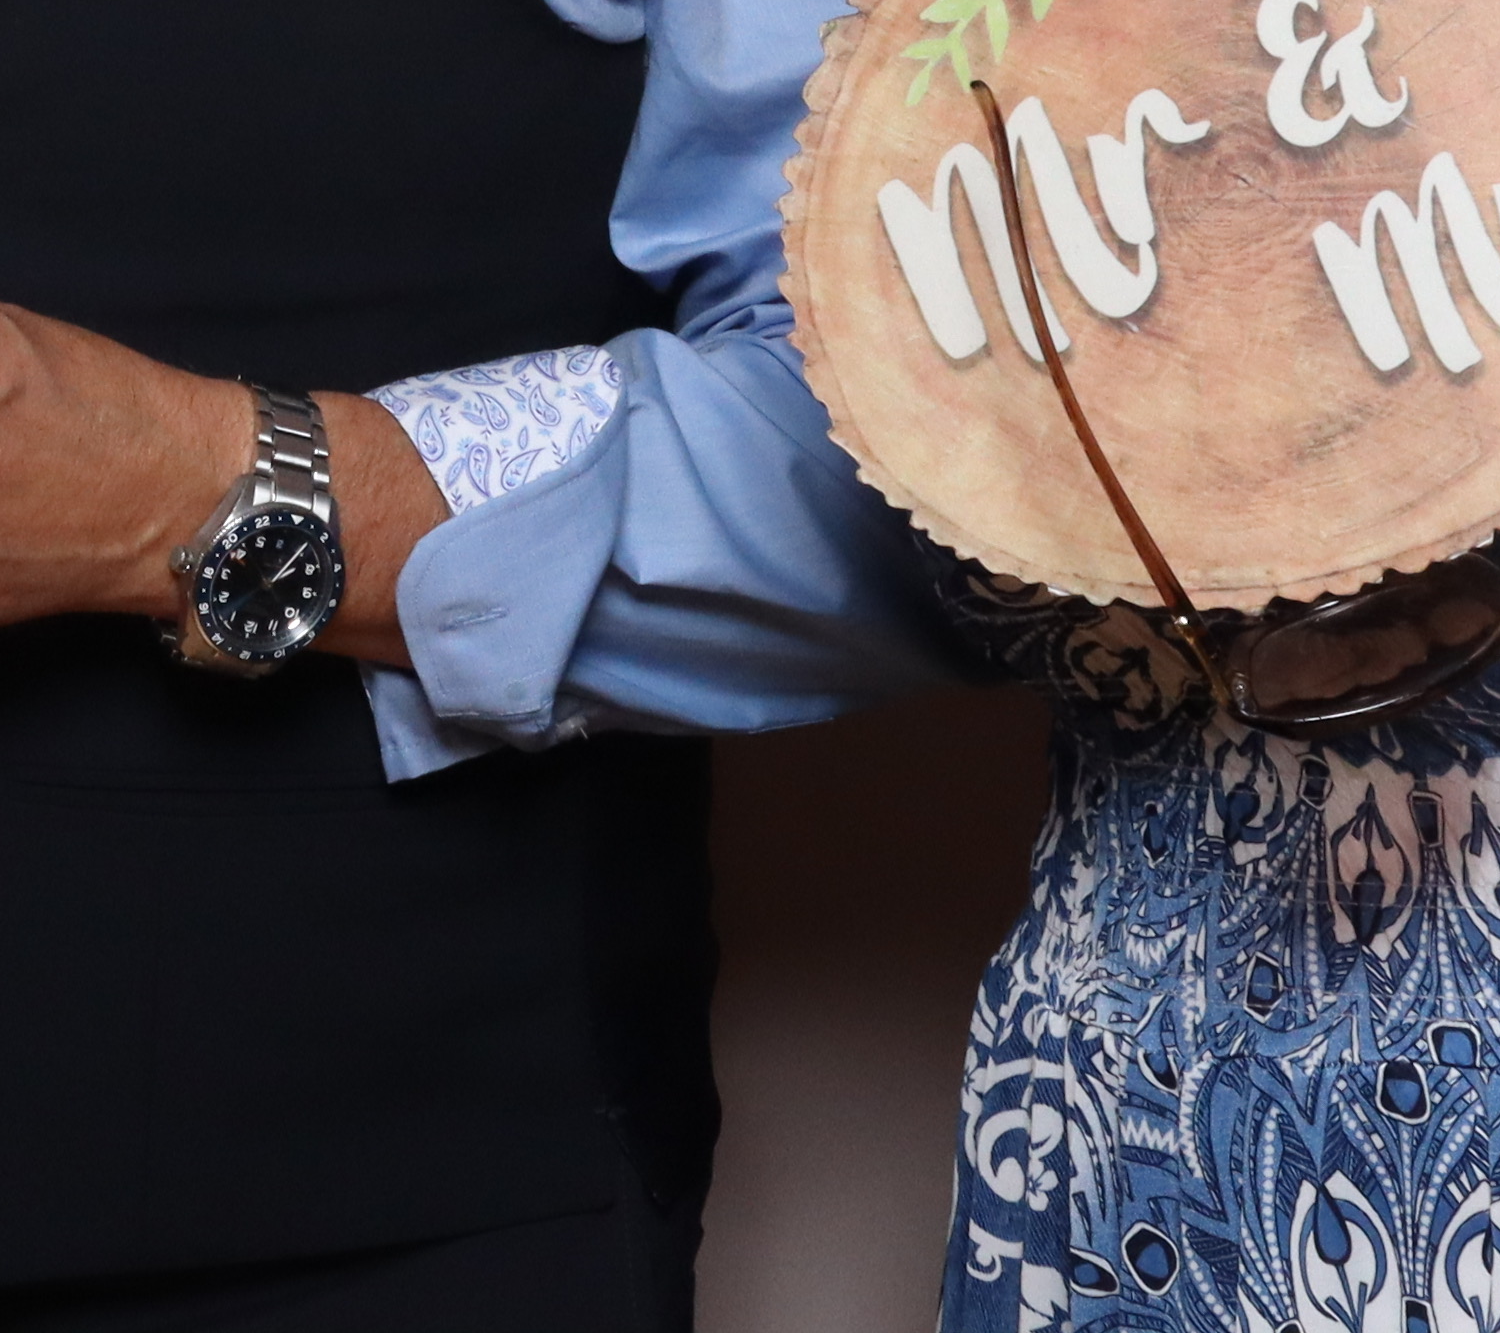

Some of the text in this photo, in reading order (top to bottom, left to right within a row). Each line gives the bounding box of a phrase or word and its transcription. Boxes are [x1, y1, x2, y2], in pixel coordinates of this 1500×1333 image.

[877, 87, 1211, 363] Mr
[254, 515, 271, 529] 22
[222, 533, 238, 550] 20
[255, 536, 266, 548] 5
[221, 568, 231, 580] 3
[218, 591, 230, 603] 2
[243, 620, 258, 634] 12
